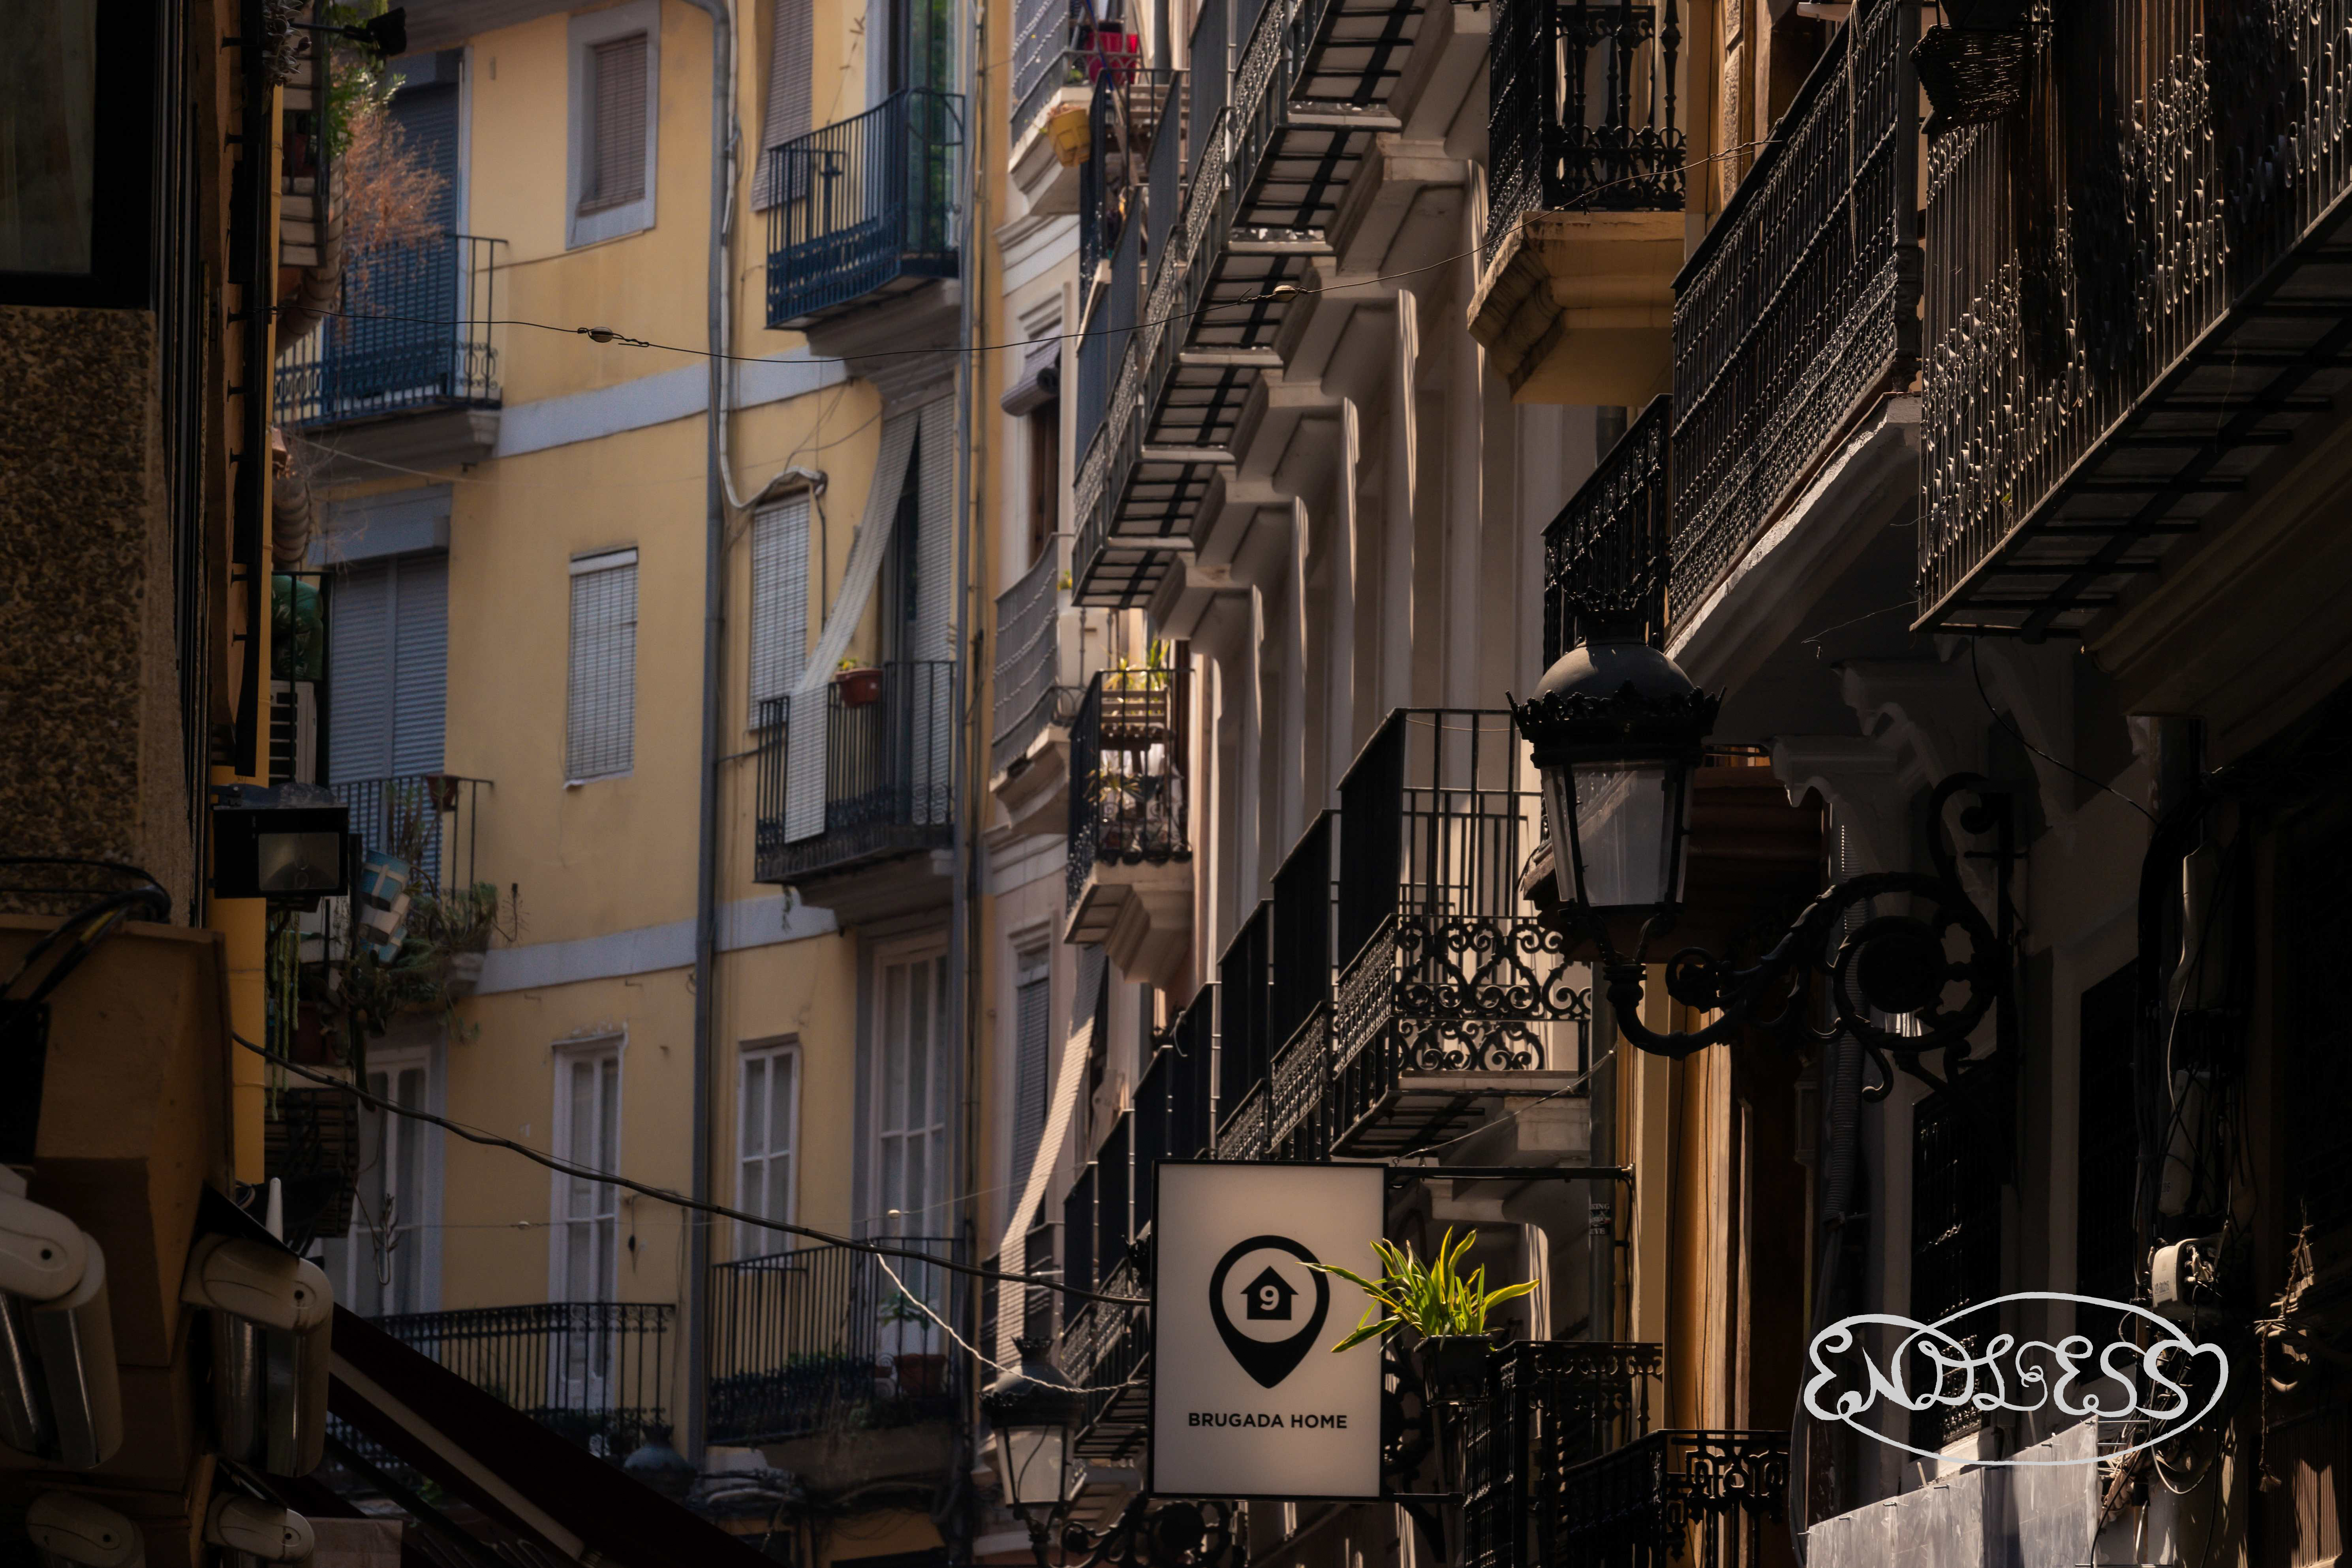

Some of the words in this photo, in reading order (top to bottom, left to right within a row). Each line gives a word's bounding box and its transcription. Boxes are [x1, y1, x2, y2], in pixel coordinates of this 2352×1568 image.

[1259, 1285, 1279, 1311] 9
[1188, 1413, 1284, 1427] BRUGADA
[1291, 1415, 1347, 1429] HOME
